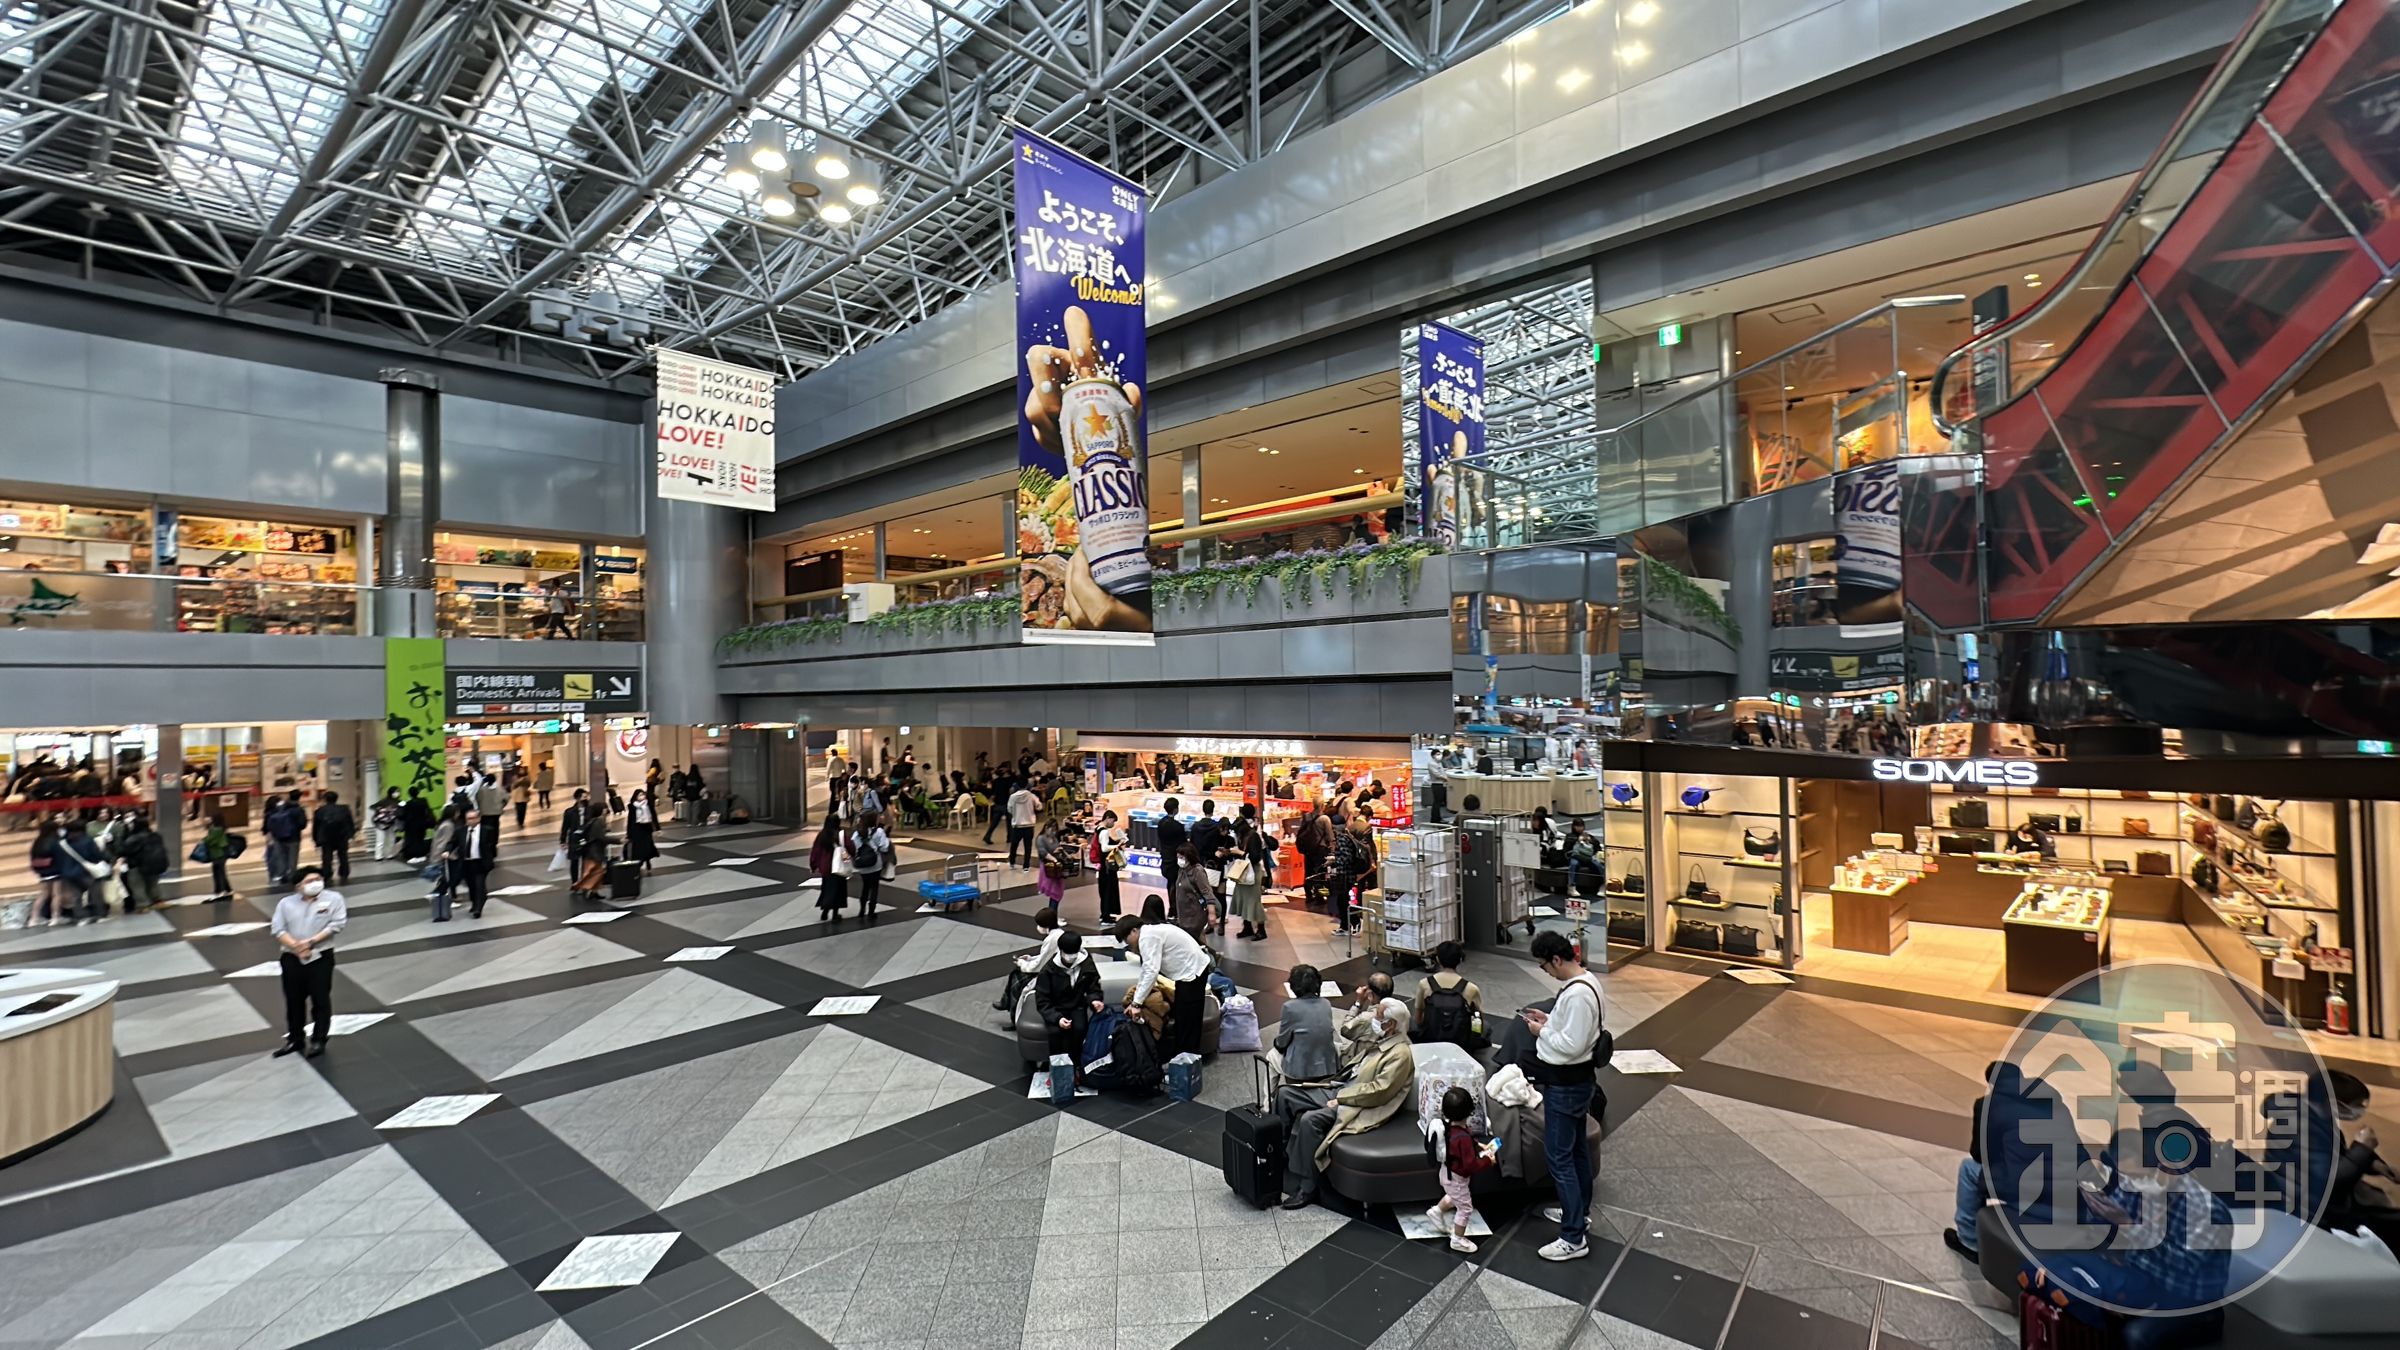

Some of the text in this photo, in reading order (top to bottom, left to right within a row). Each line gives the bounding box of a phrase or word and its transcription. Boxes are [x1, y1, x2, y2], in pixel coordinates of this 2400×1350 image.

[1112, 185, 1139, 202] ONLY
[1038, 189, 1124, 246] ようこそ、
[1020, 226, 1139, 296] 北海道へ。
[1071, 275, 1143, 305] Welcome!
[658, 399, 775, 435] HOKKAIDO
[658, 422, 726, 449] LOVE!
[1086, 440, 1115, 452] SAPPORO
[671, 454, 716, 471] LOVE!
[456, 675, 535, 688] 国内線到着
[456, 687, 514, 699] Domestic
[516, 687, 562, 699] Arrivals
[1873, 759, 2038, 785] SOMES
